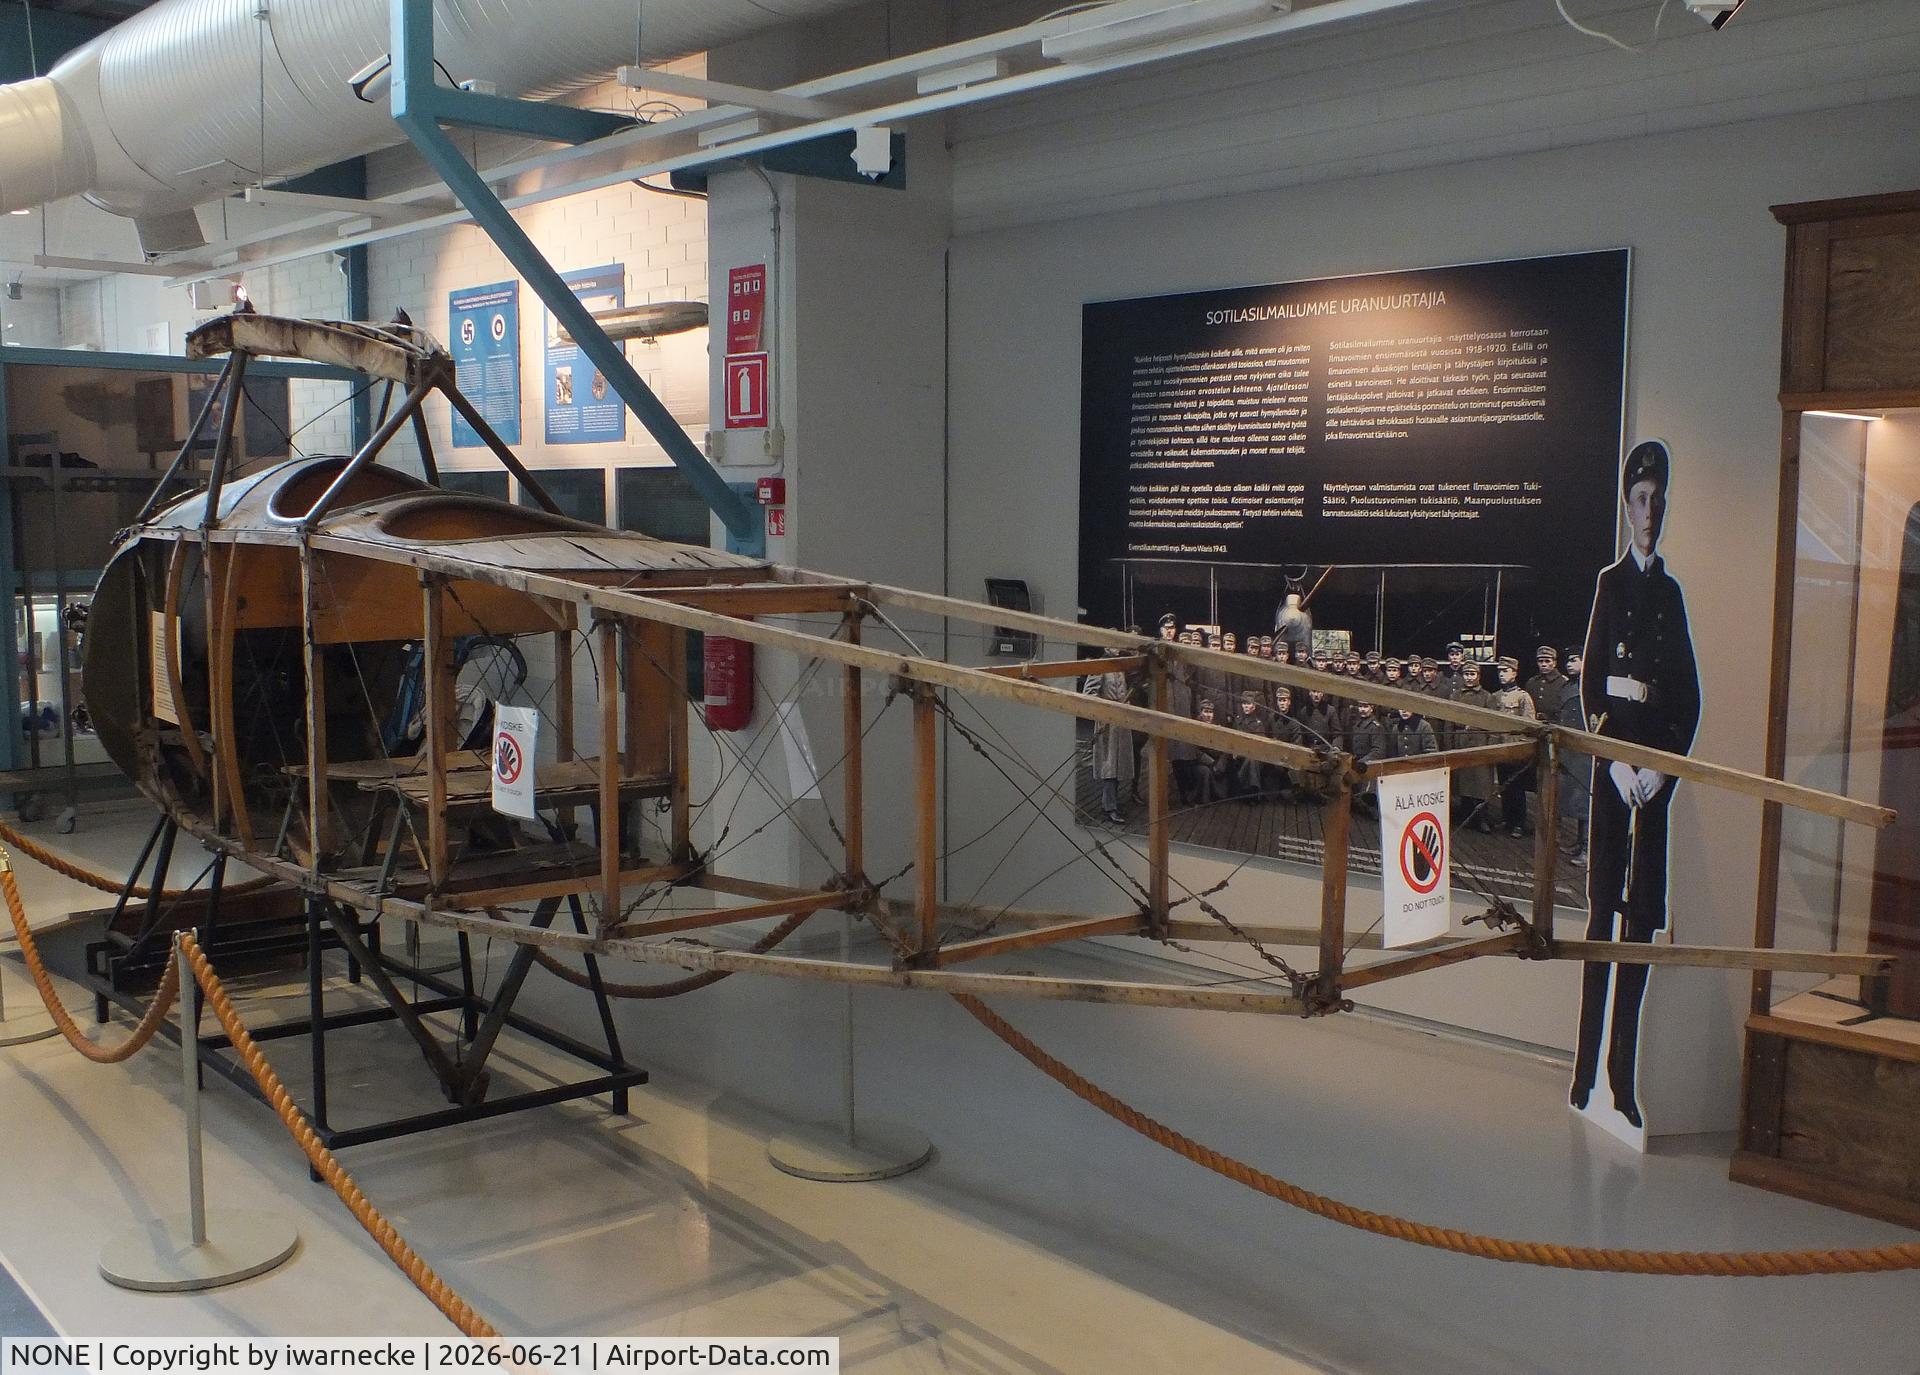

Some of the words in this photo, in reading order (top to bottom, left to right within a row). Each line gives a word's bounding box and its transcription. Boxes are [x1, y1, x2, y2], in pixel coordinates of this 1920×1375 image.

[1206, 300, 1337, 325] SOTILASILMAILUMME
[1340, 289, 1446, 313] URANUURTAJIA
[1395, 794, 1415, 811] ÄLÄ
[1416, 790, 1445, 807] KOSKE
[1402, 903, 1414, 913] DO
[1414, 899, 1428, 910] NOT
